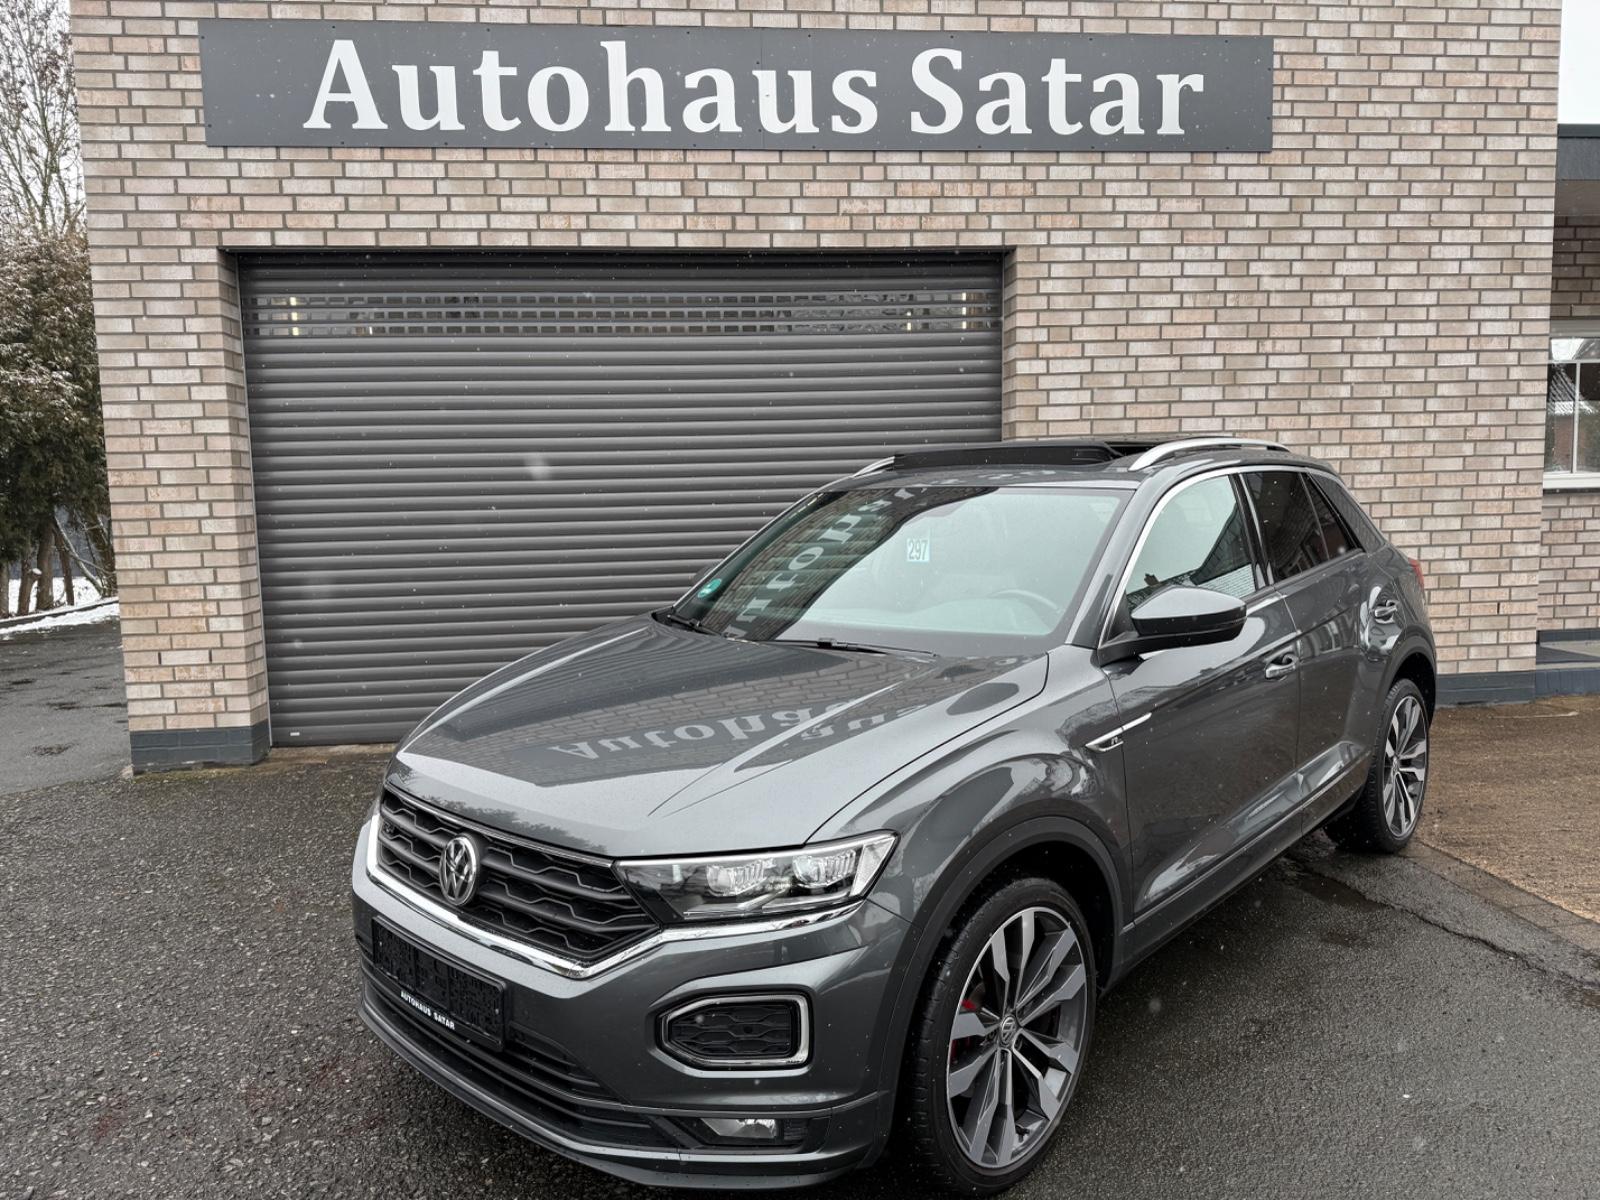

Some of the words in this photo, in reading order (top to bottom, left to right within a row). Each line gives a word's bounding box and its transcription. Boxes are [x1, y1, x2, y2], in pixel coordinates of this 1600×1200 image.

[302, 39, 879, 134] Autohaus
[910, 47, 1204, 136] Satar
[908, 537, 929, 561] 297
[400, 989, 432, 1017] AUTOHAUS
[433, 1011, 456, 1031] SATAR
